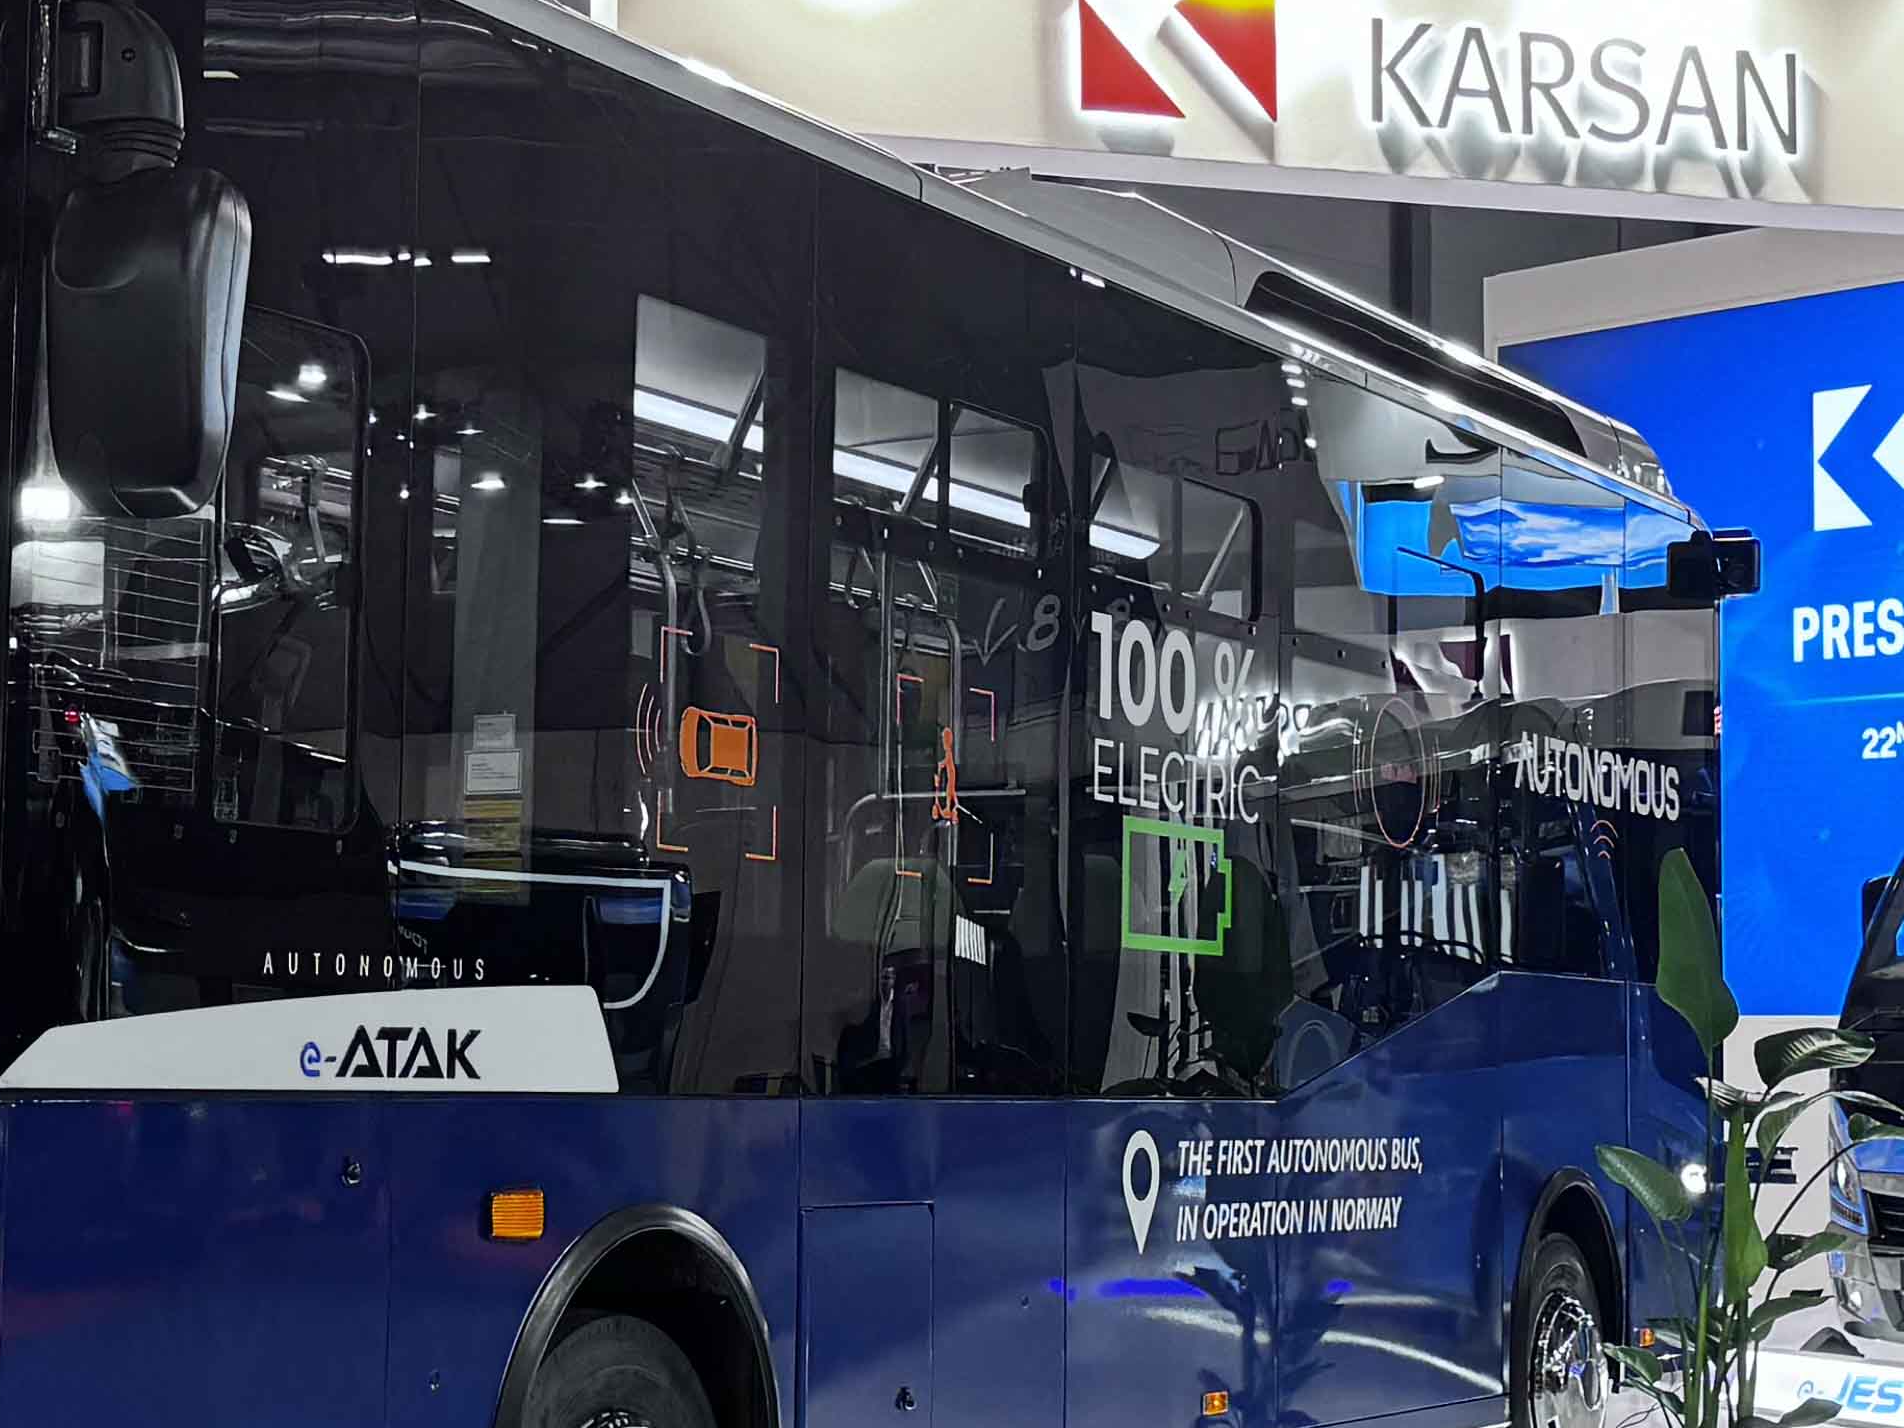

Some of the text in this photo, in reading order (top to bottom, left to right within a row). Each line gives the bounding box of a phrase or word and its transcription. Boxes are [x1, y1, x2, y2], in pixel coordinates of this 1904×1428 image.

[1370, 18, 1798, 155] KARSAN
[1091, 613, 1194, 735] 100
[1094, 739, 1260, 824] ELECTRIC
[1515, 731, 1680, 822] AUTONOMOUS
[263, 950, 487, 981] AUTONOMOUS
[299, 1024, 481, 1079] e-ATAK
[1177, 1135, 1424, 1176] THE FIRST AUTONOMOUS BUS,
[1177, 1195, 1403, 1242] IN OPERATION IN NORWAY
